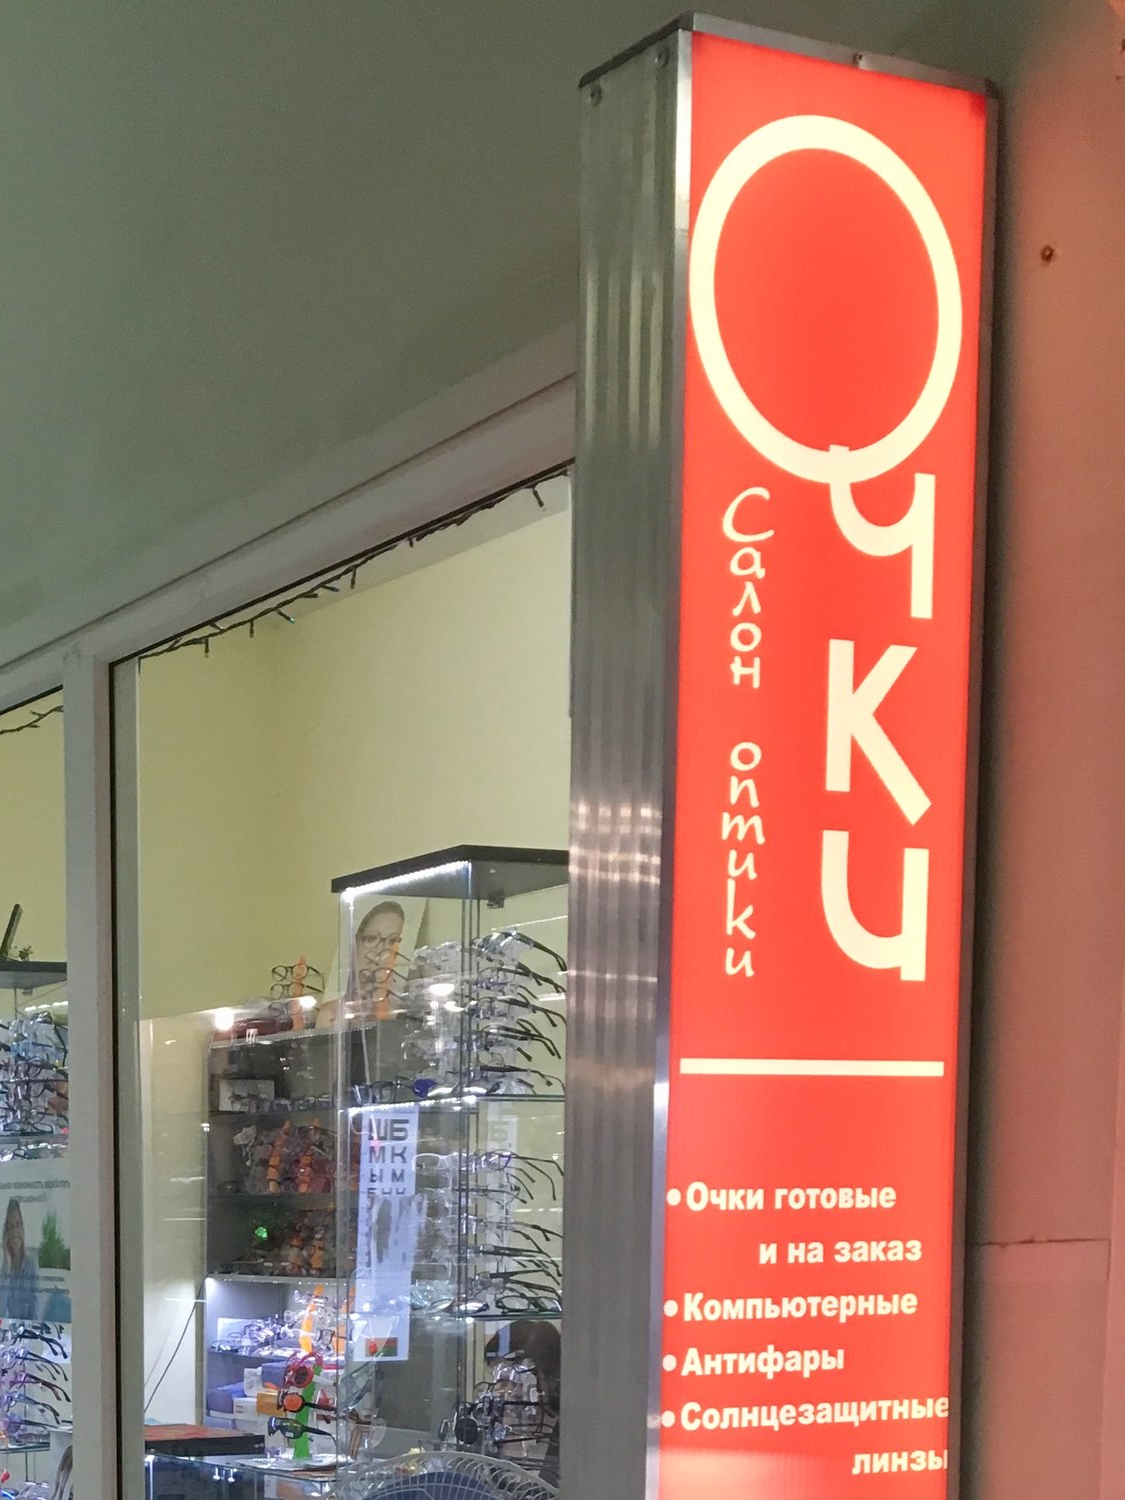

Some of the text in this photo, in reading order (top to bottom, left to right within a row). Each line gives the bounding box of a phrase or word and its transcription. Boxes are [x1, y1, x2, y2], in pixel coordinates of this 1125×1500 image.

[721, 487, 775, 977] Салон оптики
[686, 1181, 897, 1211] Очки готовые
[759, 1239, 922, 1264] и на заказ
[683, 1292, 918, 1323] Компьютерные
[680, 1345, 844, 1379] Антифары
[680, 1396, 949, 1431] Солнцезащитные
[851, 1449, 948, 1475] линзы
